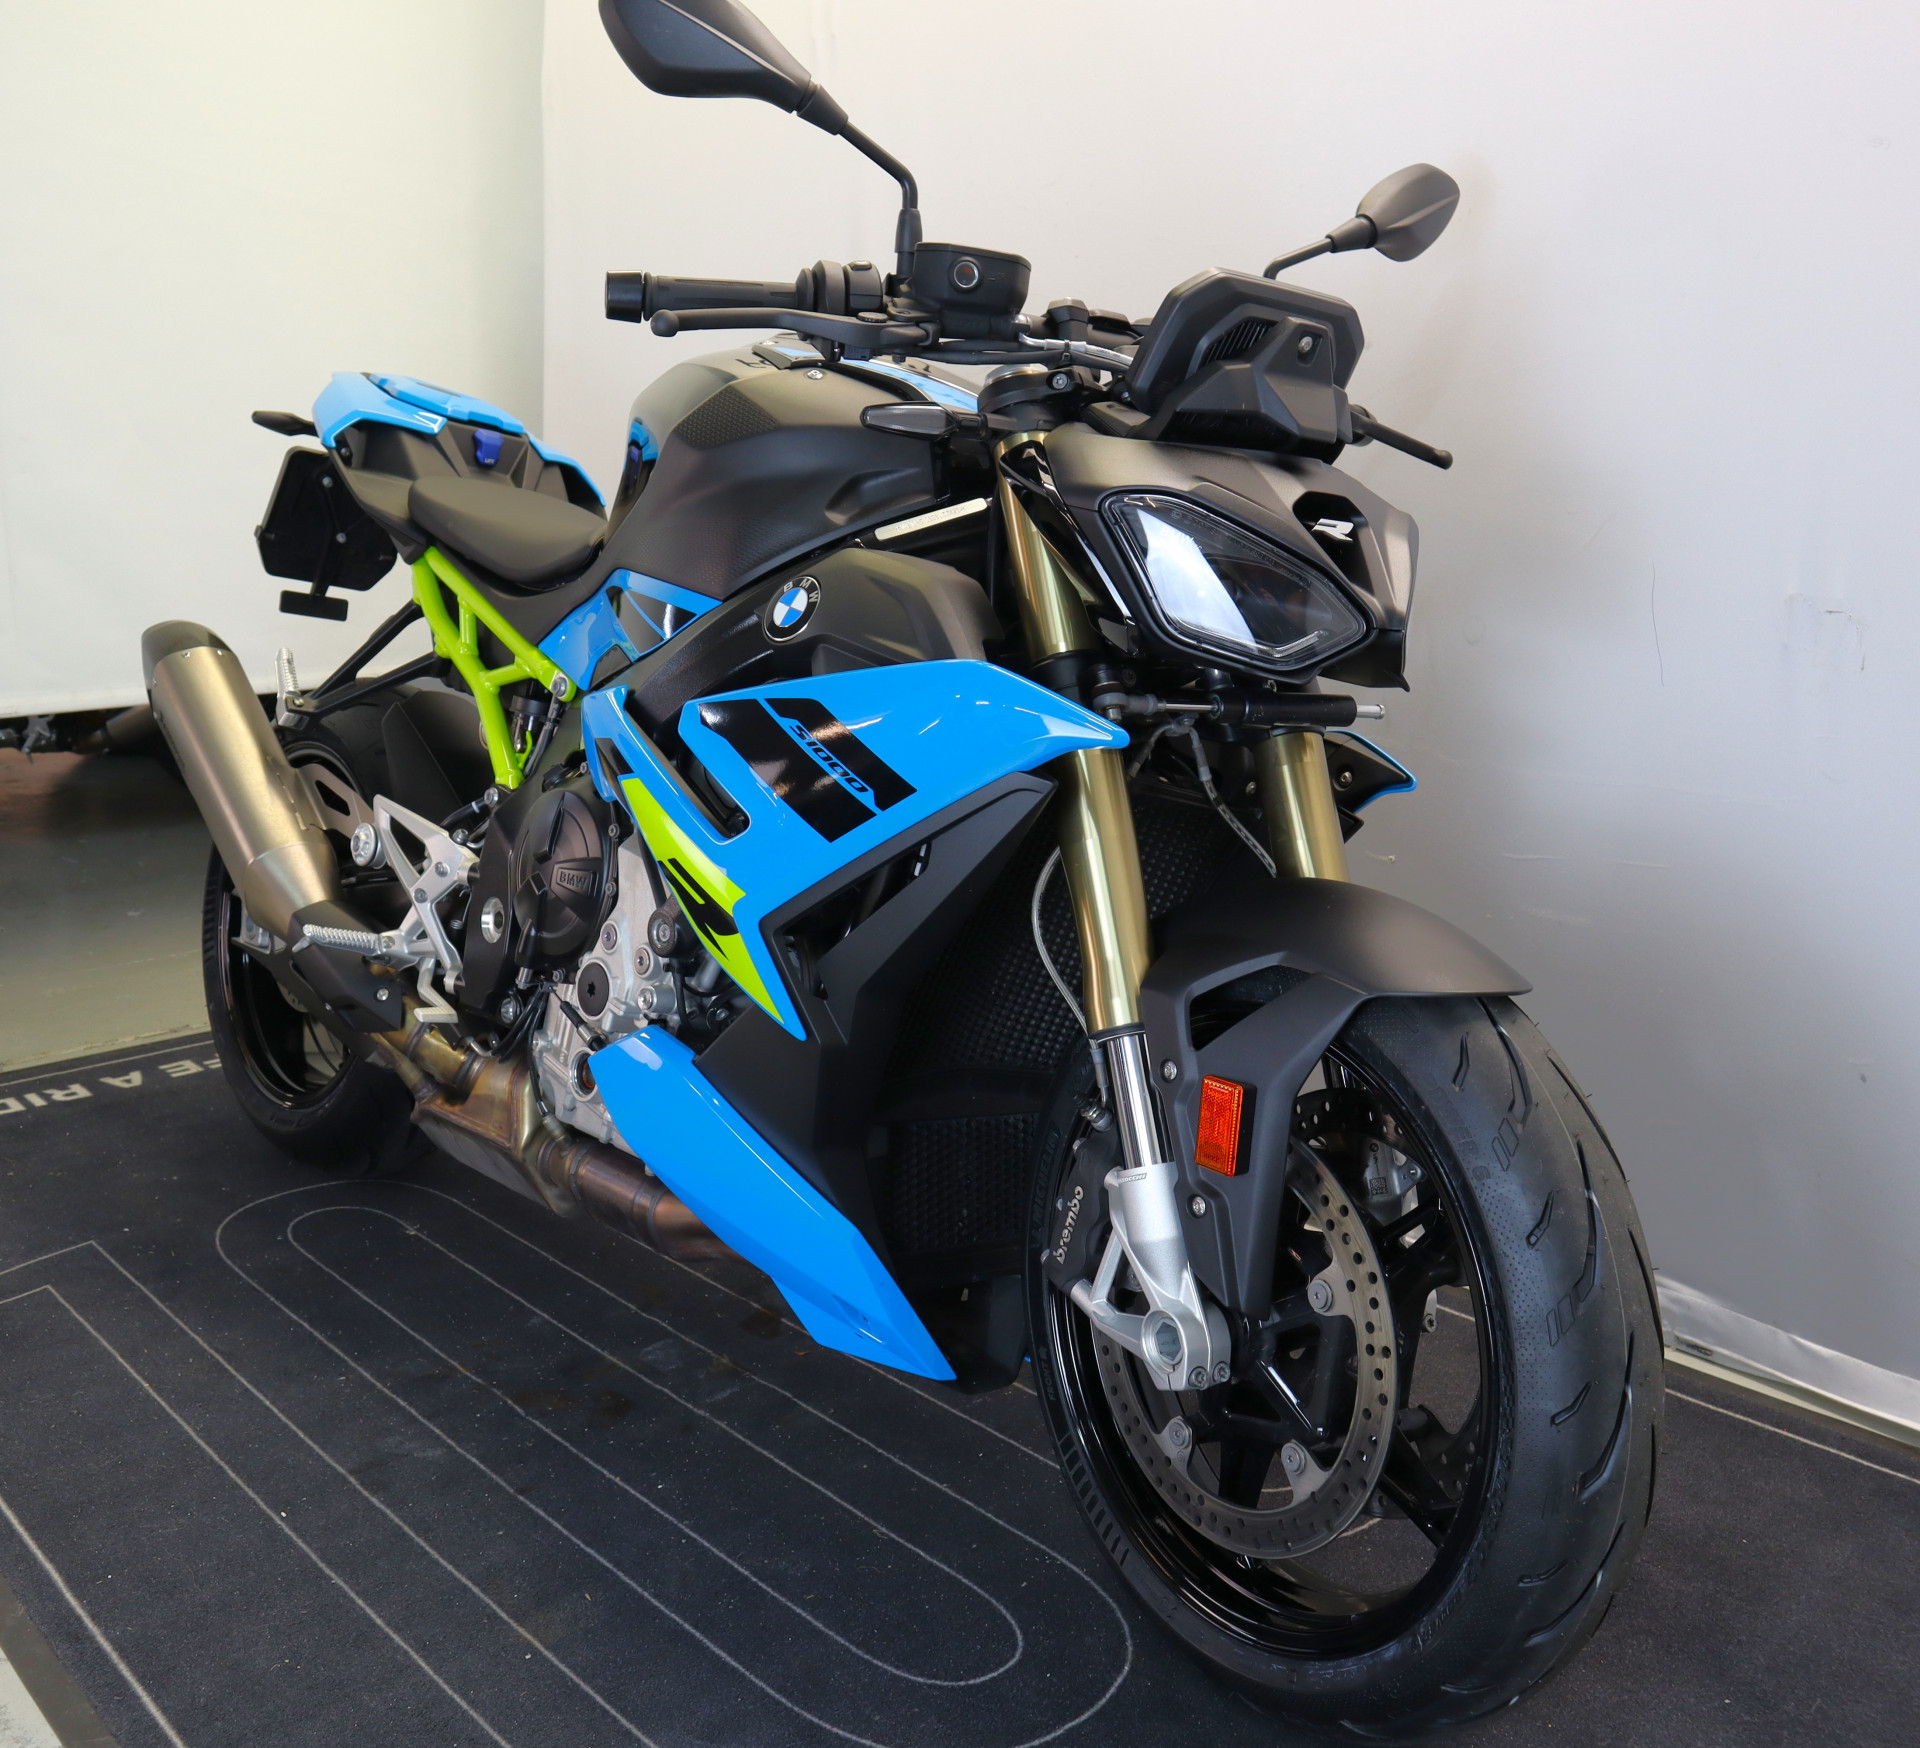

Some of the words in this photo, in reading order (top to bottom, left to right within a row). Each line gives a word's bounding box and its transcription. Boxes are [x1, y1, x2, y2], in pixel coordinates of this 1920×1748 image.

[1311, 518, 1354, 542] R
[783, 578, 819, 603] BMW
[789, 724, 869, 793] S1000
[559, 870, 587, 889] BMW
[99, 1070, 144, 1089] A
[1033, 1126, 1061, 1227] MICHELIN
[1053, 1185, 1084, 1265] brembo
